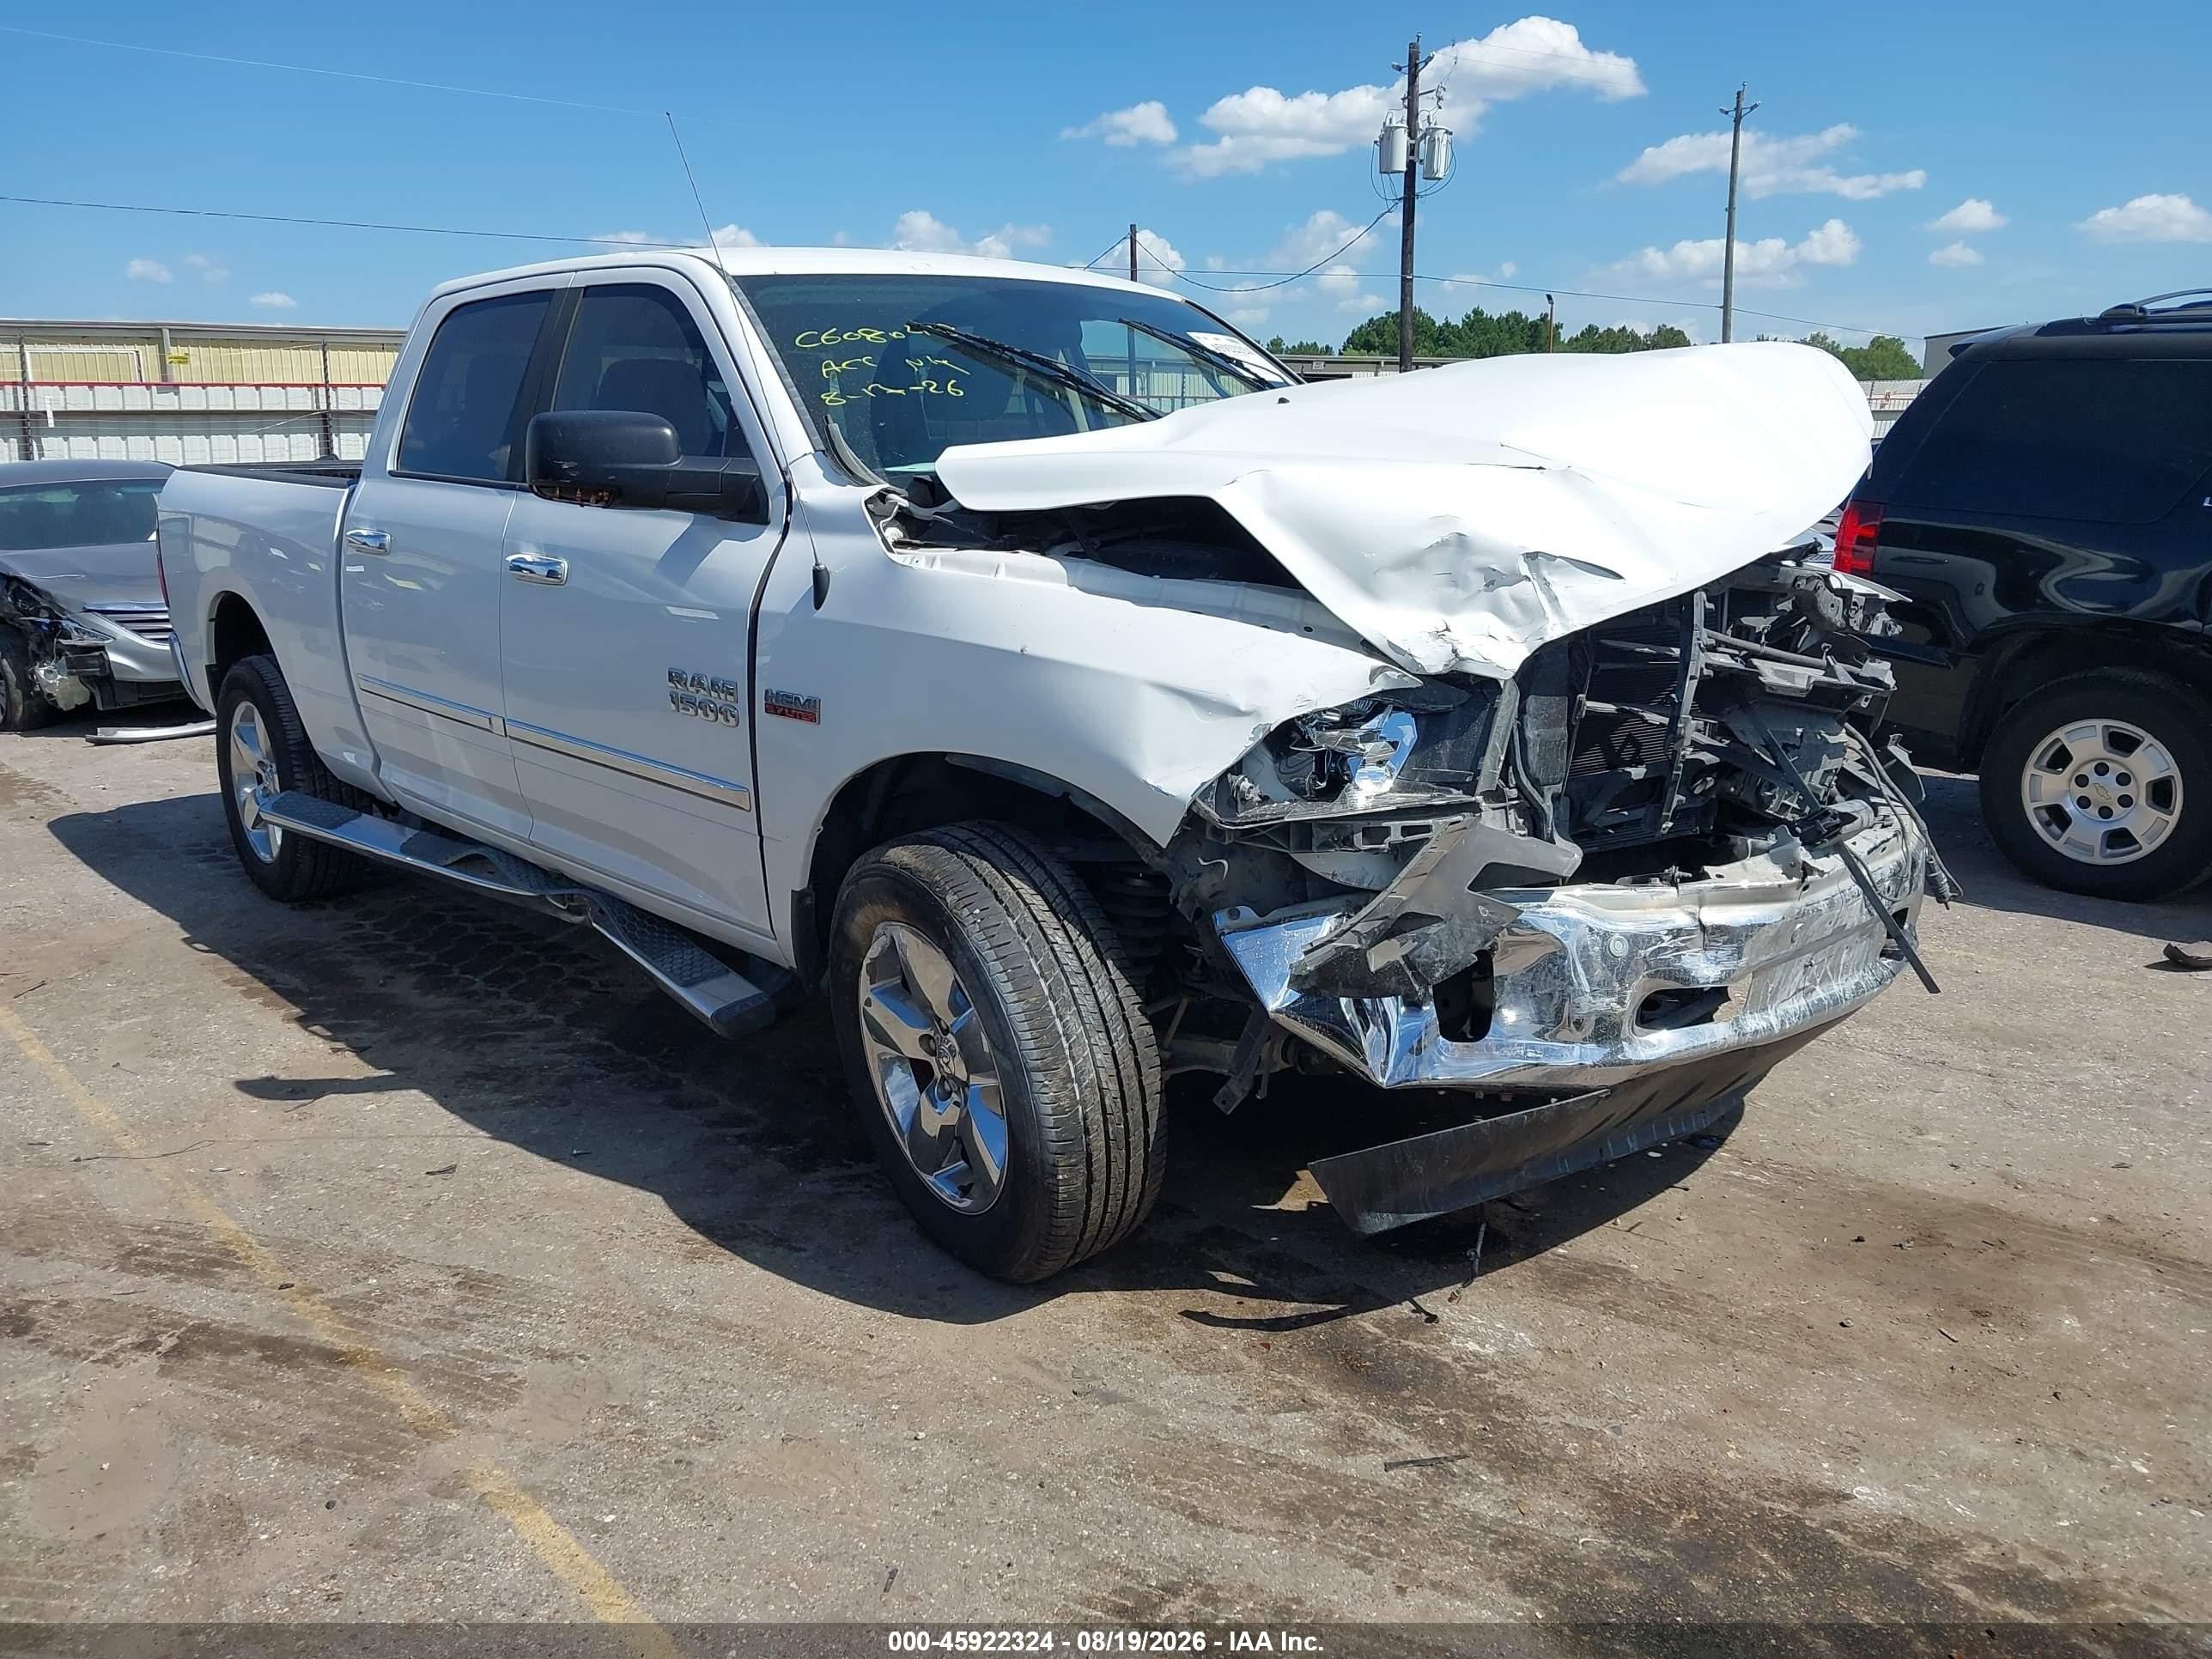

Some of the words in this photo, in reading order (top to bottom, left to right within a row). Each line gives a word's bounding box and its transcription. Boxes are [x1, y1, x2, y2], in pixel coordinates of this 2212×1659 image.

[667, 666, 738, 703] RAM
[764, 687, 818, 710] HEMI
[669, 690, 740, 727] 1500
